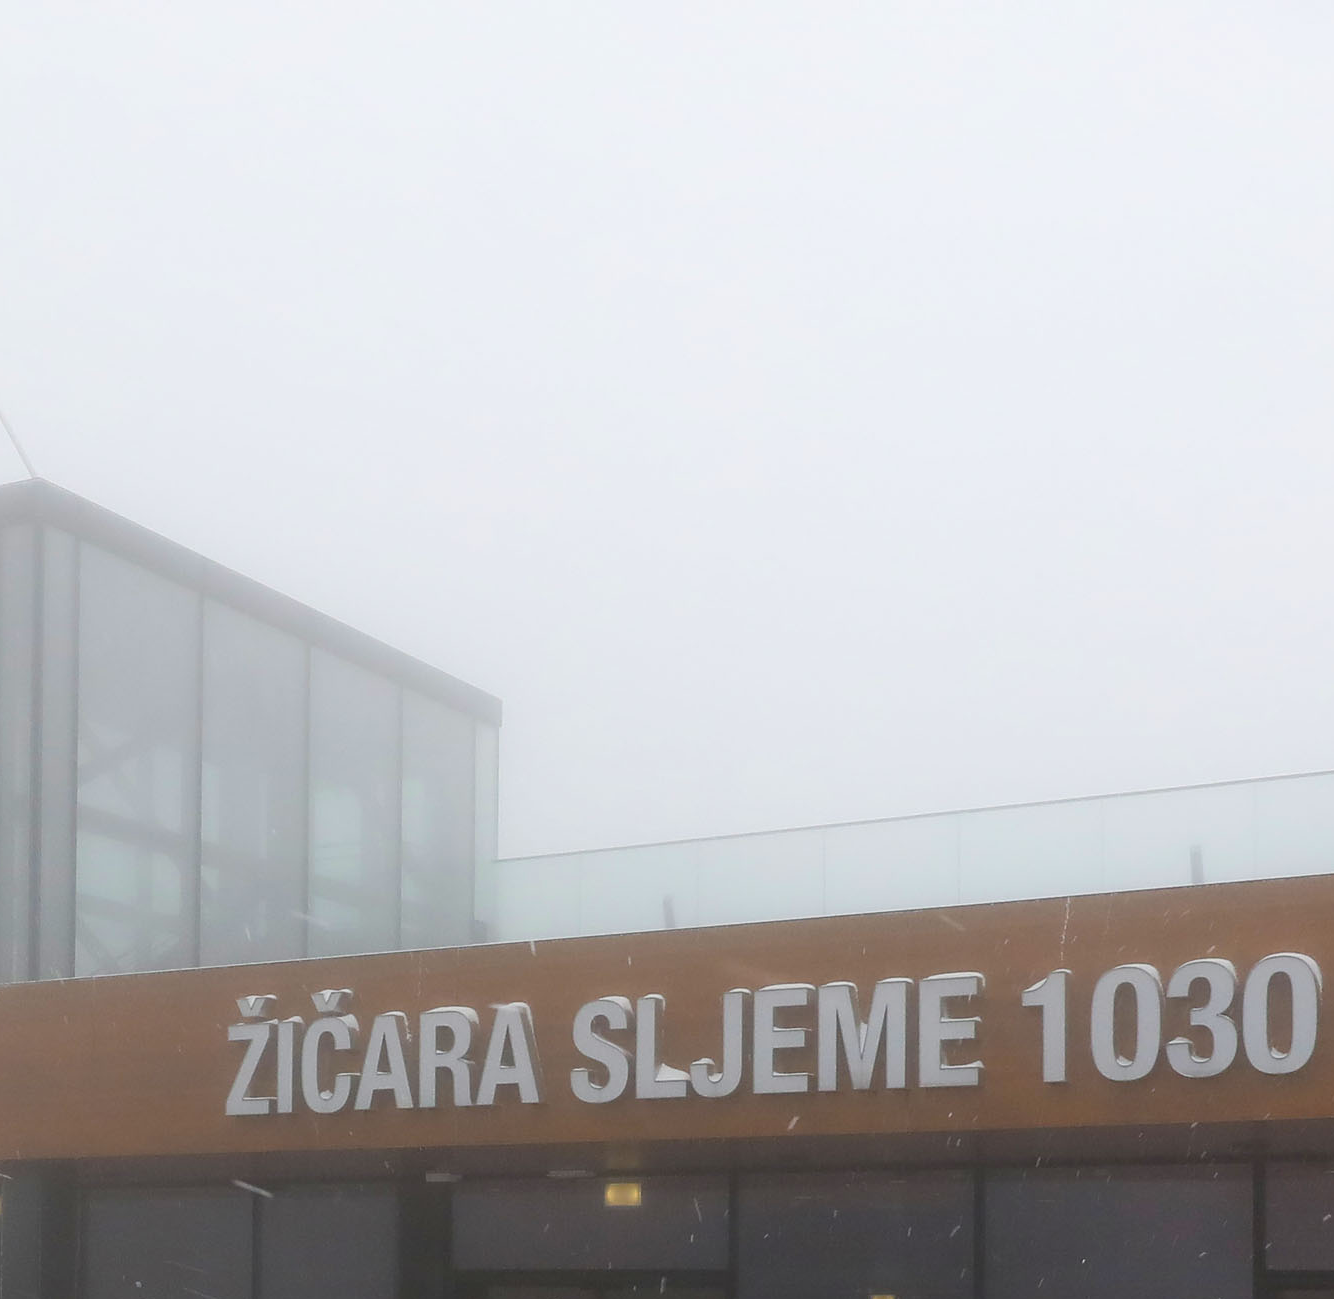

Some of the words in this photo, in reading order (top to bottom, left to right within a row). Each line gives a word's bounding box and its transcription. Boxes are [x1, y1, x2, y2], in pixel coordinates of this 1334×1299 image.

[225, 988, 540, 1117] ŽIČARA
[571, 971, 984, 1105] SLJEME
[1021, 952, 1322, 1083] 1030
